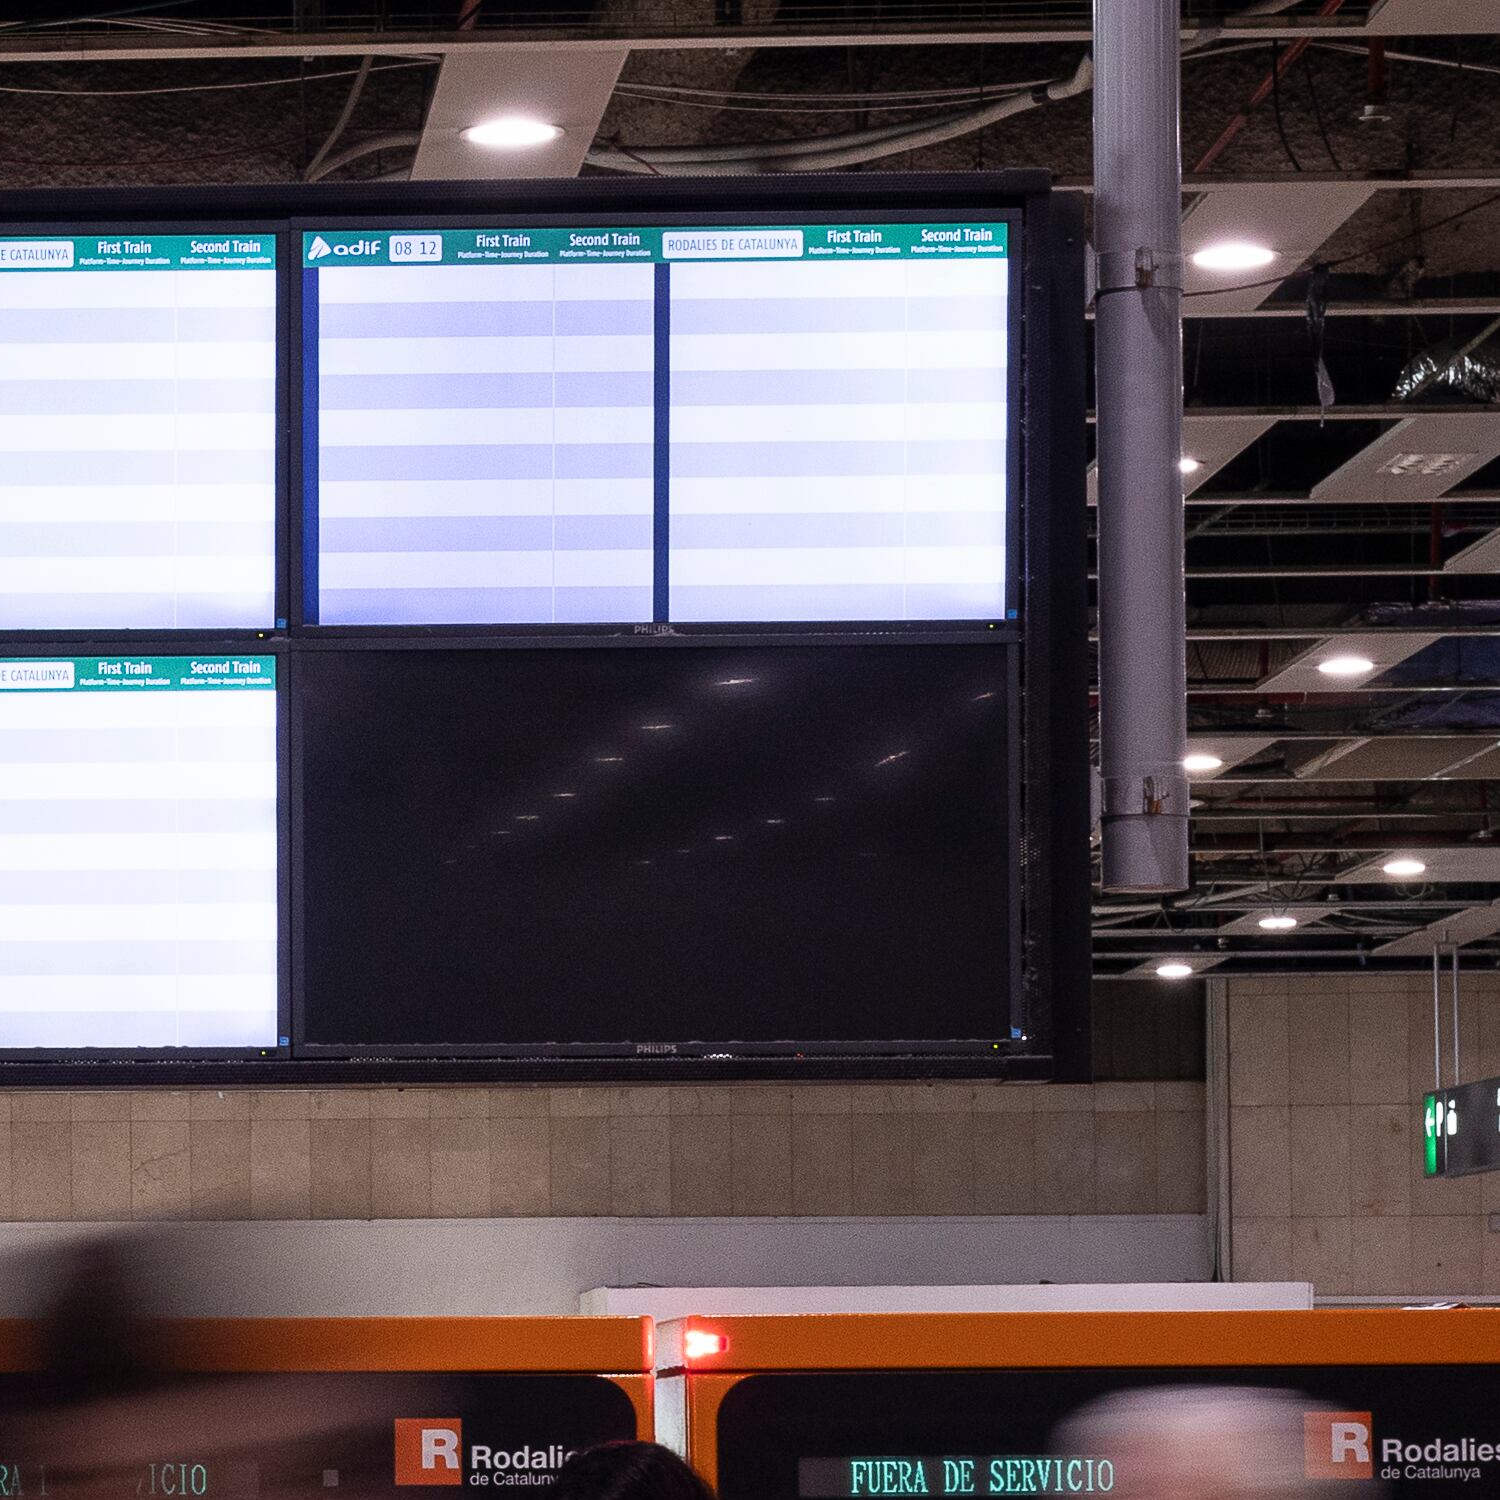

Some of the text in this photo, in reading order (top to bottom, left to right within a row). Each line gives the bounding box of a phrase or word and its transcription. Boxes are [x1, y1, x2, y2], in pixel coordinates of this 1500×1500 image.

[333, 239, 381, 256] adif
[668, 238, 798, 252] RODALIES DE CATALUNYA
[470, 1472, 489, 1486] de
[851, 1460, 1114, 1494] FUERA DE SERVICIO
[1381, 1465, 1481, 1482] de Catalunya
